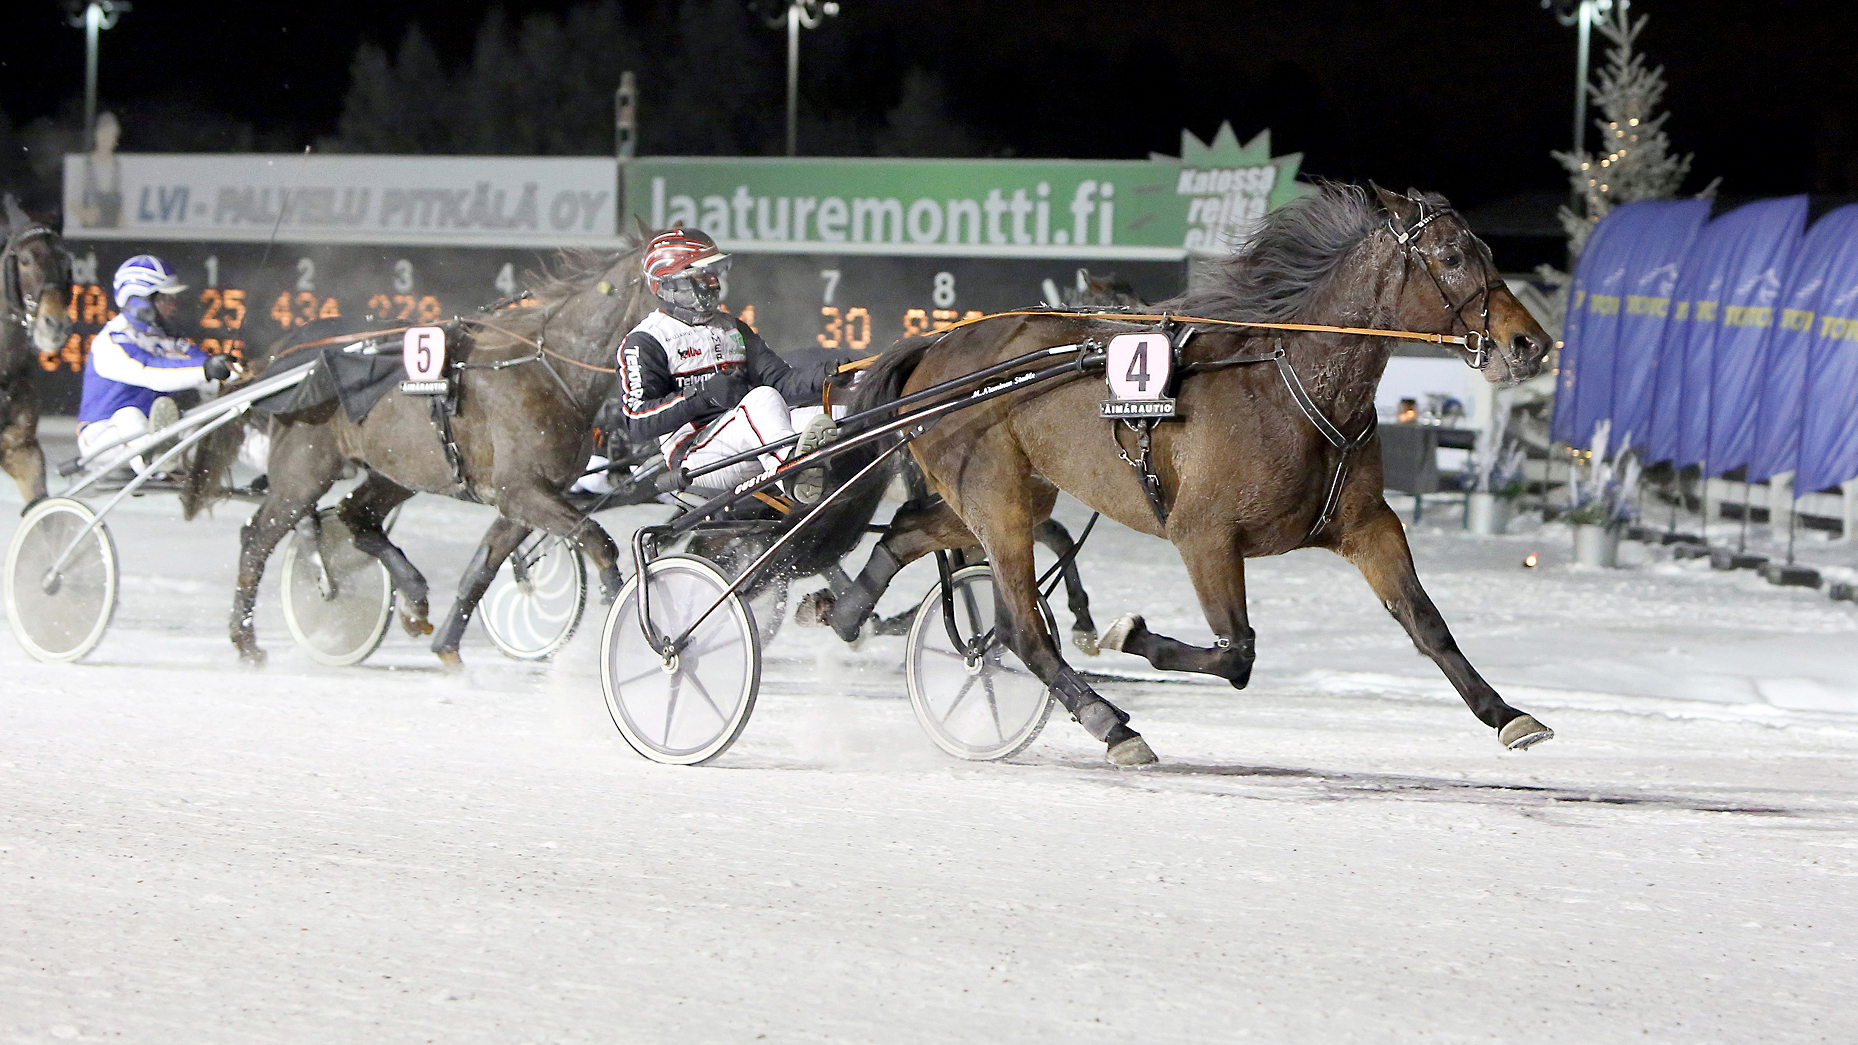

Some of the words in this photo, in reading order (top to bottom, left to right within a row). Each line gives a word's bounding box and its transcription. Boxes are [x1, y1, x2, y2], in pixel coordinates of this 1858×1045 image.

[138, 185, 190, 222] LVI
[214, 186, 370, 225] PALVELU
[379, 180, 539, 230] PITKÄLÄ
[550, 190, 609, 231] OY
[652, 176, 1114, 244] laaturemontti.fi
[205, 256, 219, 287] 1
[297, 258, 315, 291] 2
[395, 260, 413, 293] 3
[495, 262, 516, 297] 4
[820, 270, 840, 304] 7
[932, 271, 956, 308] 8
[201, 289, 246, 328] 25
[817, 307, 871, 349] 30
[417, 334, 431, 373] 5
[1126, 342, 1150, 391] 4
[735, 466, 778, 495] CUSTOM
